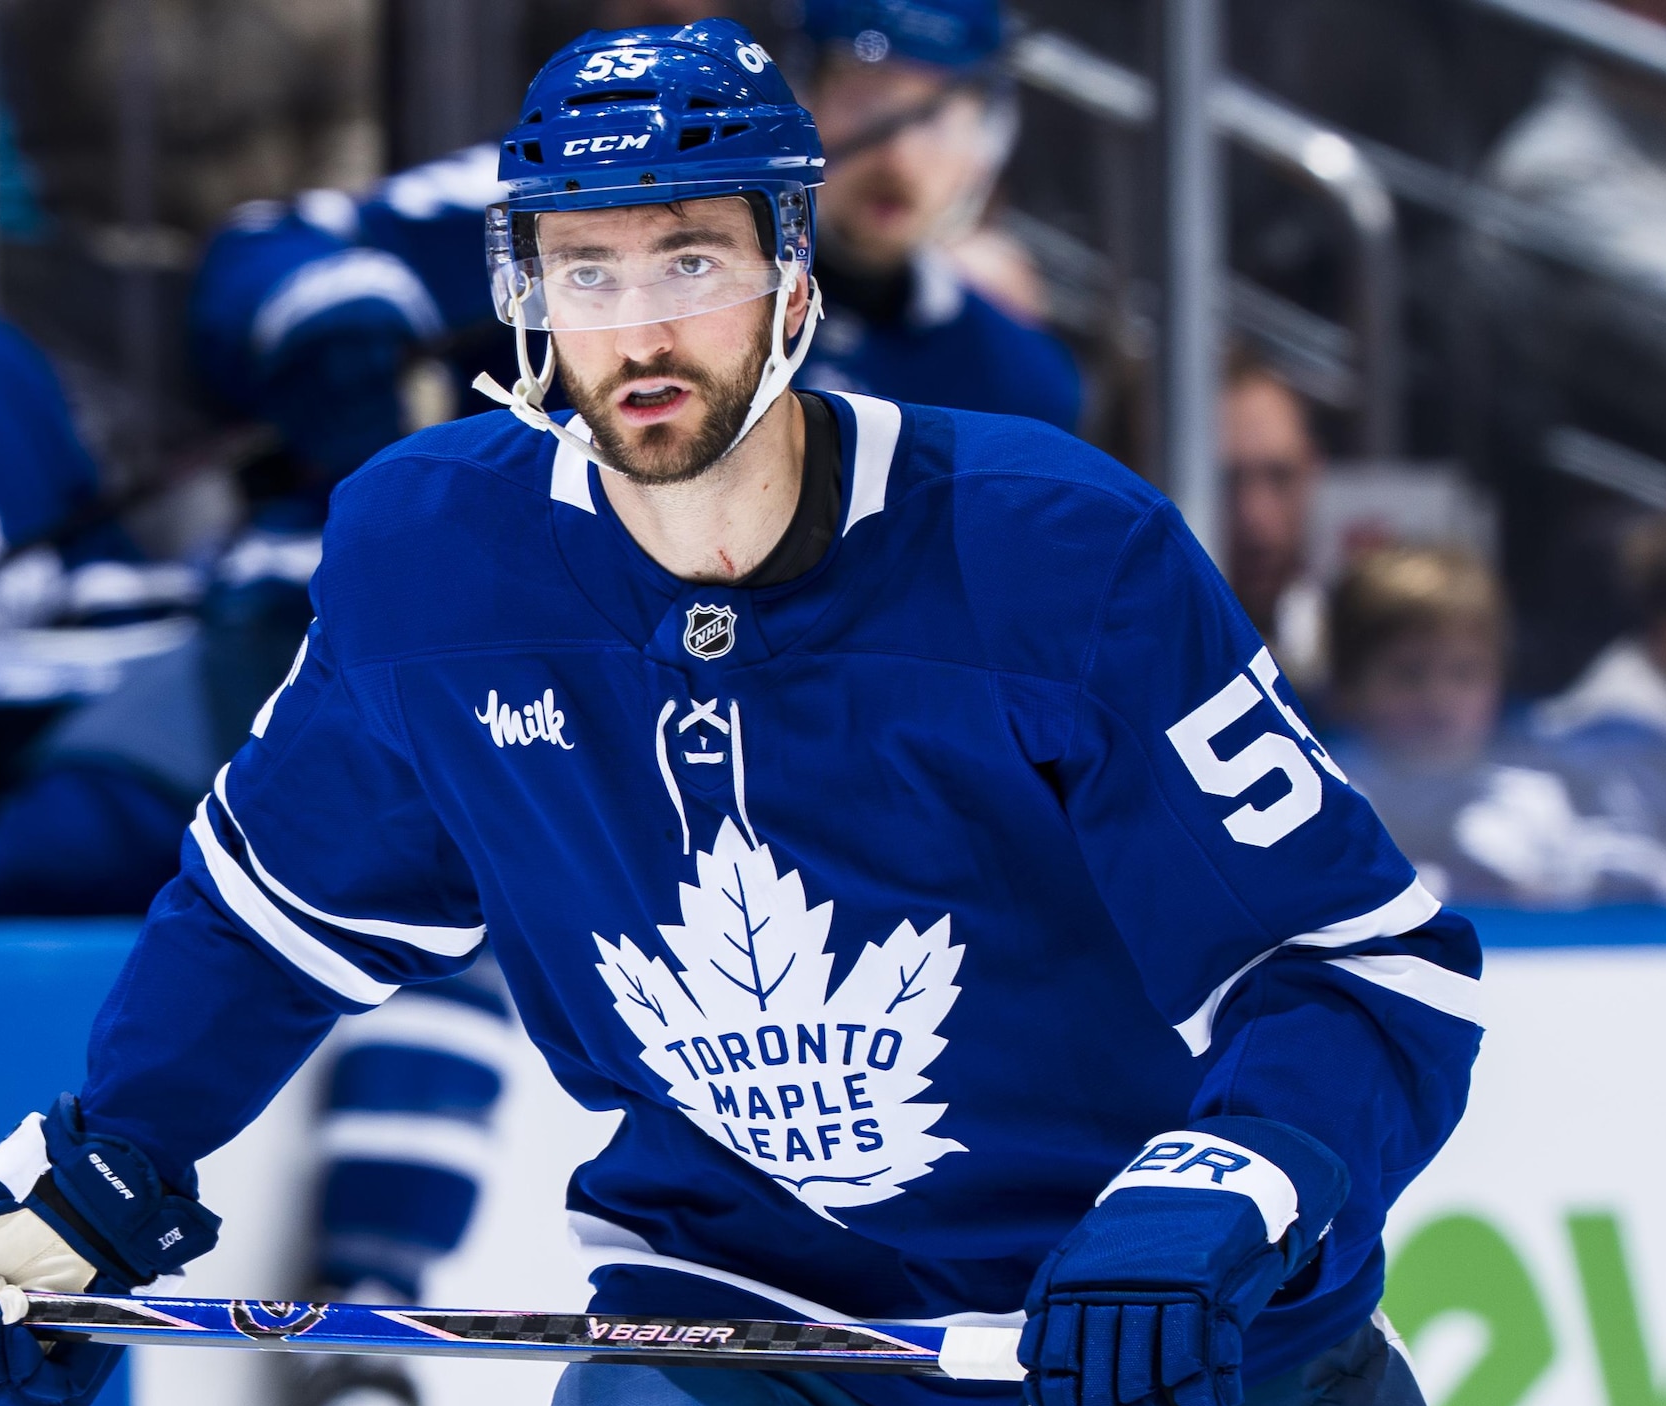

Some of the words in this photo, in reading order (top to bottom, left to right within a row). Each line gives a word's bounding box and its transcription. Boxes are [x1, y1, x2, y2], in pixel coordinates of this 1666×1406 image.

[576, 49, 656, 81] 55
[563, 133, 651, 156] CCM
[695, 620, 726, 647] NHL
[475, 688, 575, 750] Milk
[665, 1023, 903, 1081] TORONTO
[708, 1072, 873, 1120] MAPLE
[721, 1118, 884, 1162] LEAFS
[88, 1153, 135, 1200] BAUER
[607, 1322, 735, 1344] BAUER
